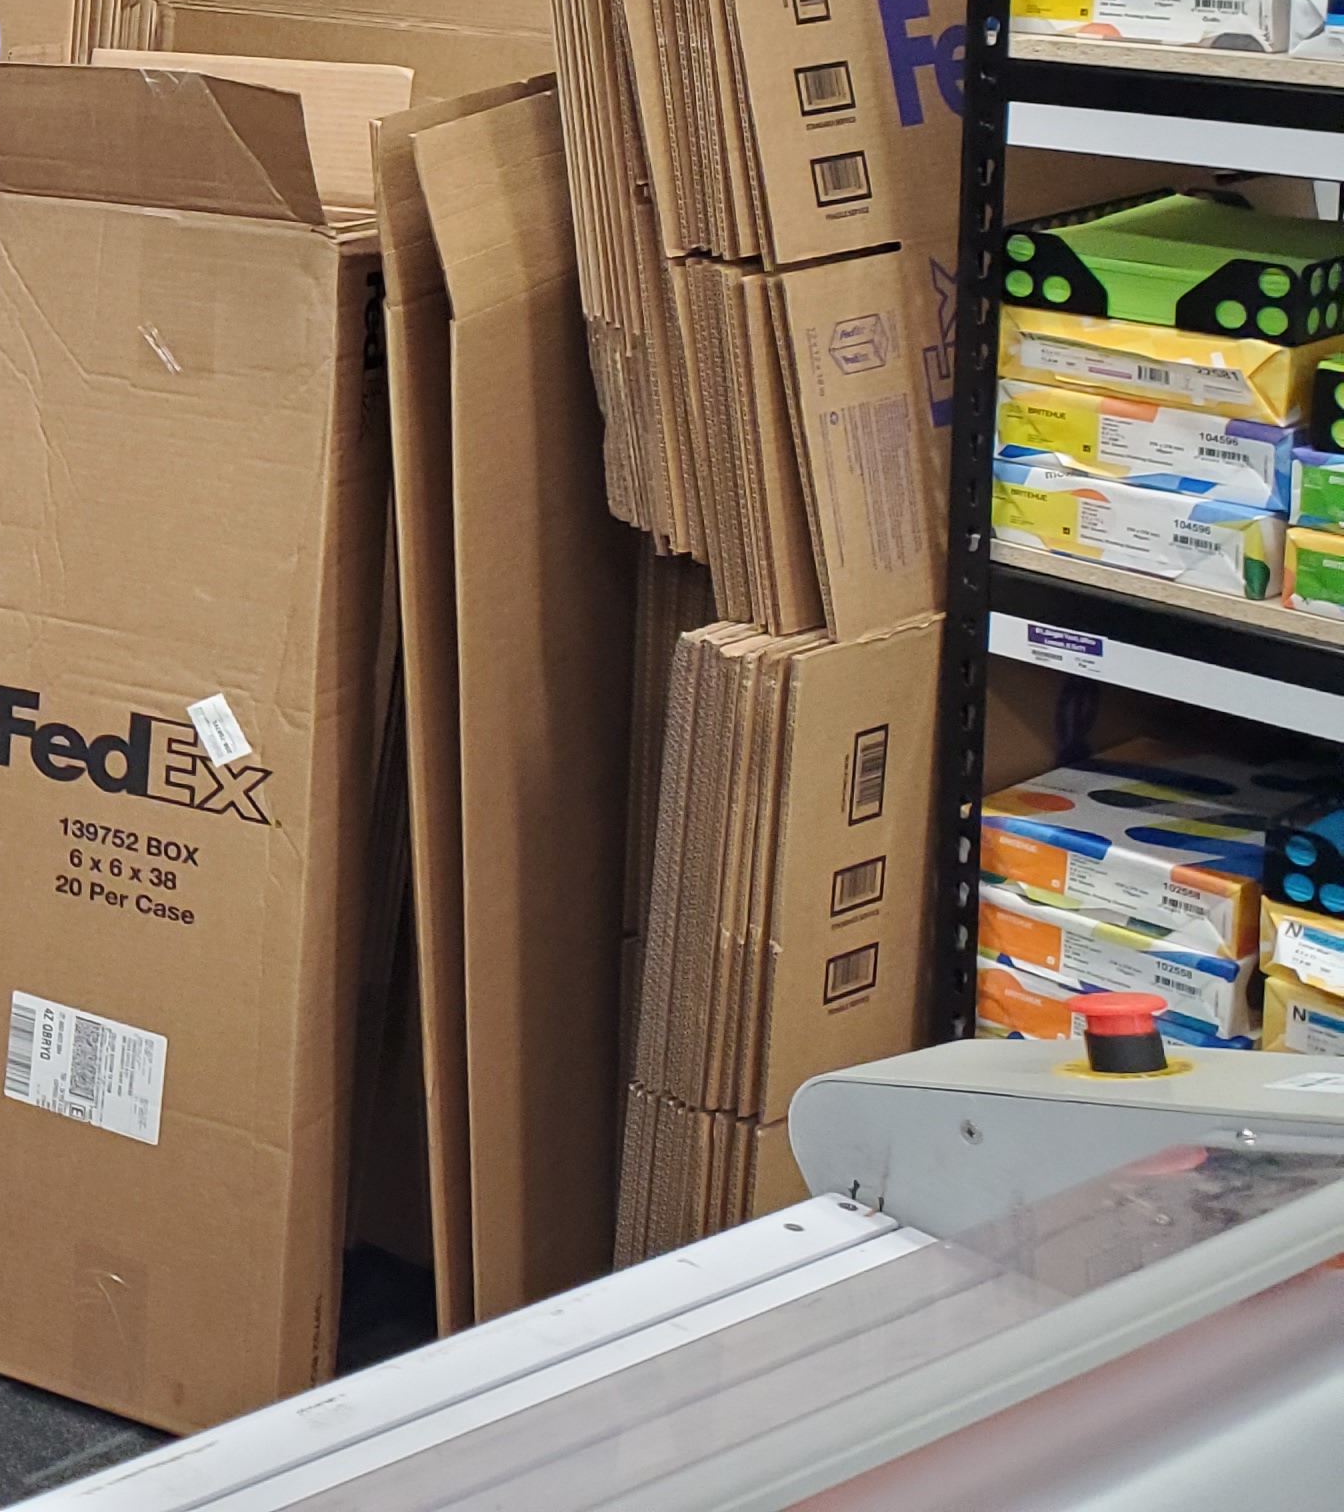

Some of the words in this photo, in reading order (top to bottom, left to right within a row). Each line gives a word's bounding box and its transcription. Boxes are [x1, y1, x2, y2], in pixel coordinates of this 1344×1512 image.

[1027, 407, 1067, 420] BRITEHUE
[1199, 432, 1239, 446] 104596
[1010, 489, 1048, 502] BRITEHUE
[1173, 519, 1212, 536] 104596
[59, 817, 139, 853] 139752
[146, 836, 200, 867] BOX
[69, 848, 83, 868] 6
[89, 856, 103, 873] x
[109, 858, 123, 878] 6
[129, 866, 143, 883] x
[149, 867, 177, 891] 38
[54, 874, 82, 896] 20
[89, 882, 129, 909] Per
[135, 894, 195, 925] Case
[1155, 960, 1193, 980] 102558
[43, 1008, 55, 1020] 4Z
[1293, 1005, 1306, 1022] N
